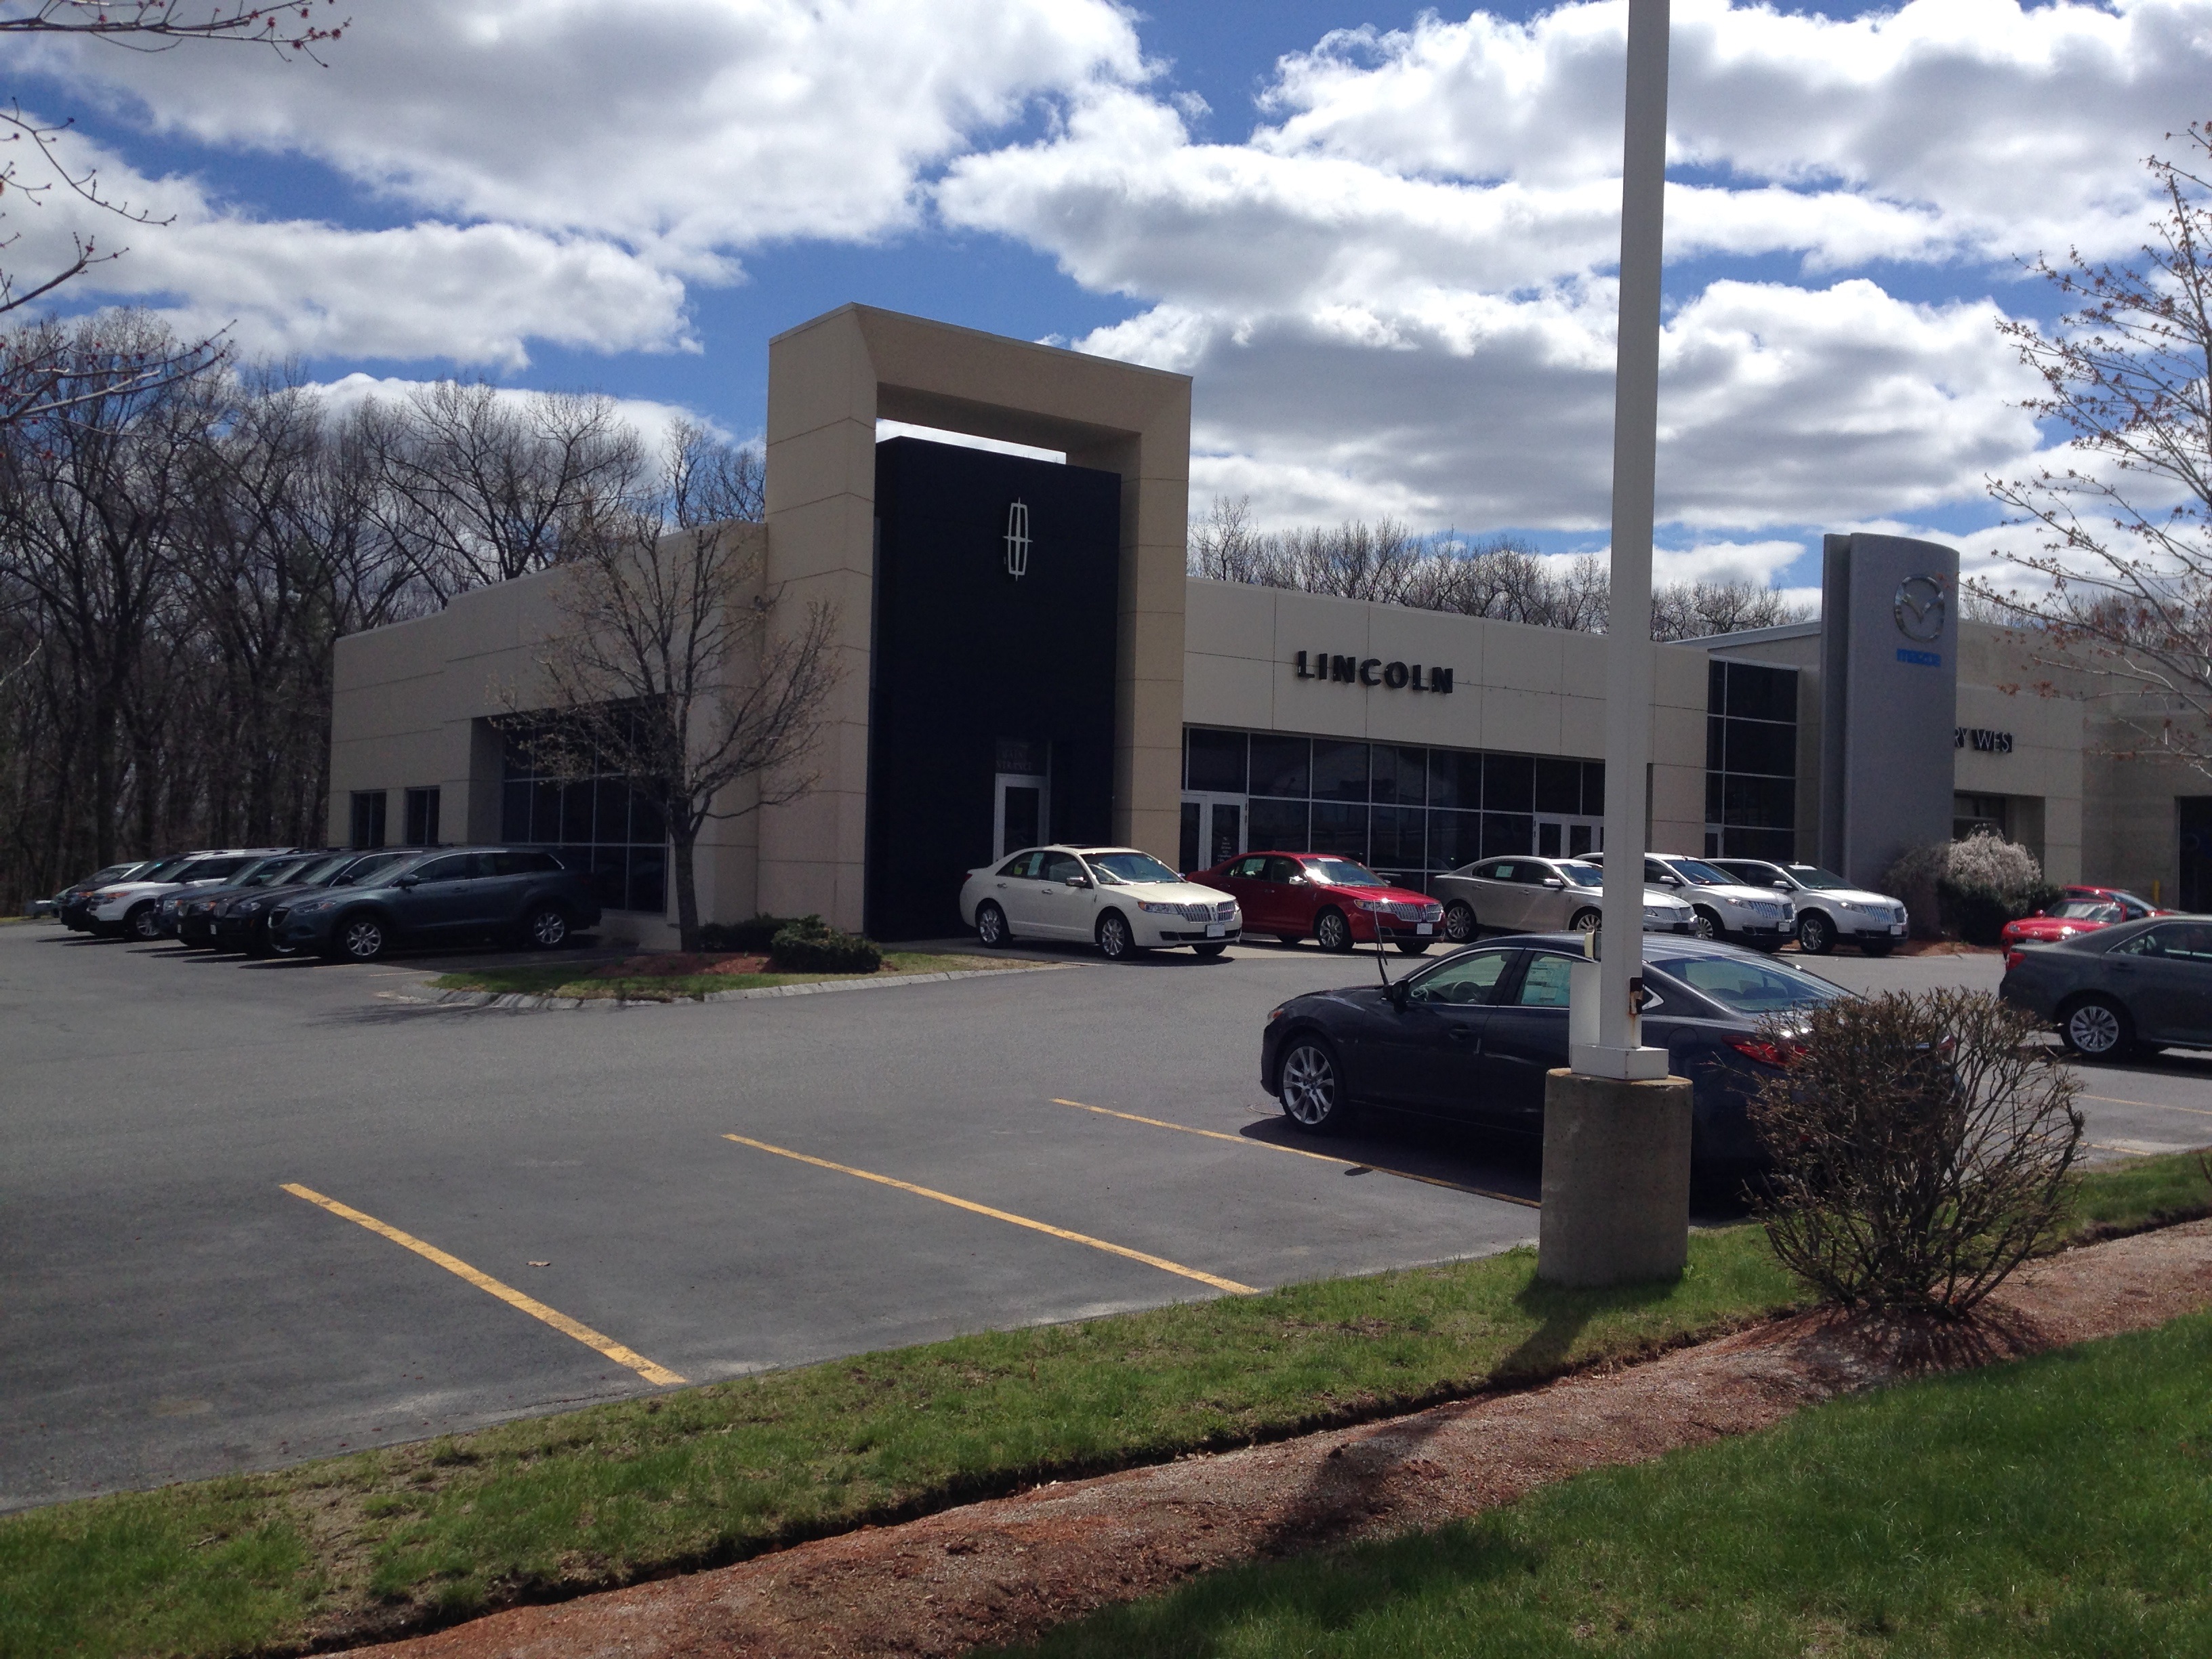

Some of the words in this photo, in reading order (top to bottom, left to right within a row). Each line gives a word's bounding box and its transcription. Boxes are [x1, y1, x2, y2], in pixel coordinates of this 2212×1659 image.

[1297, 651, 1454, 693] LINCOLN
[1954, 727, 1969, 748] RY
[1971, 729, 2013, 753] WES
